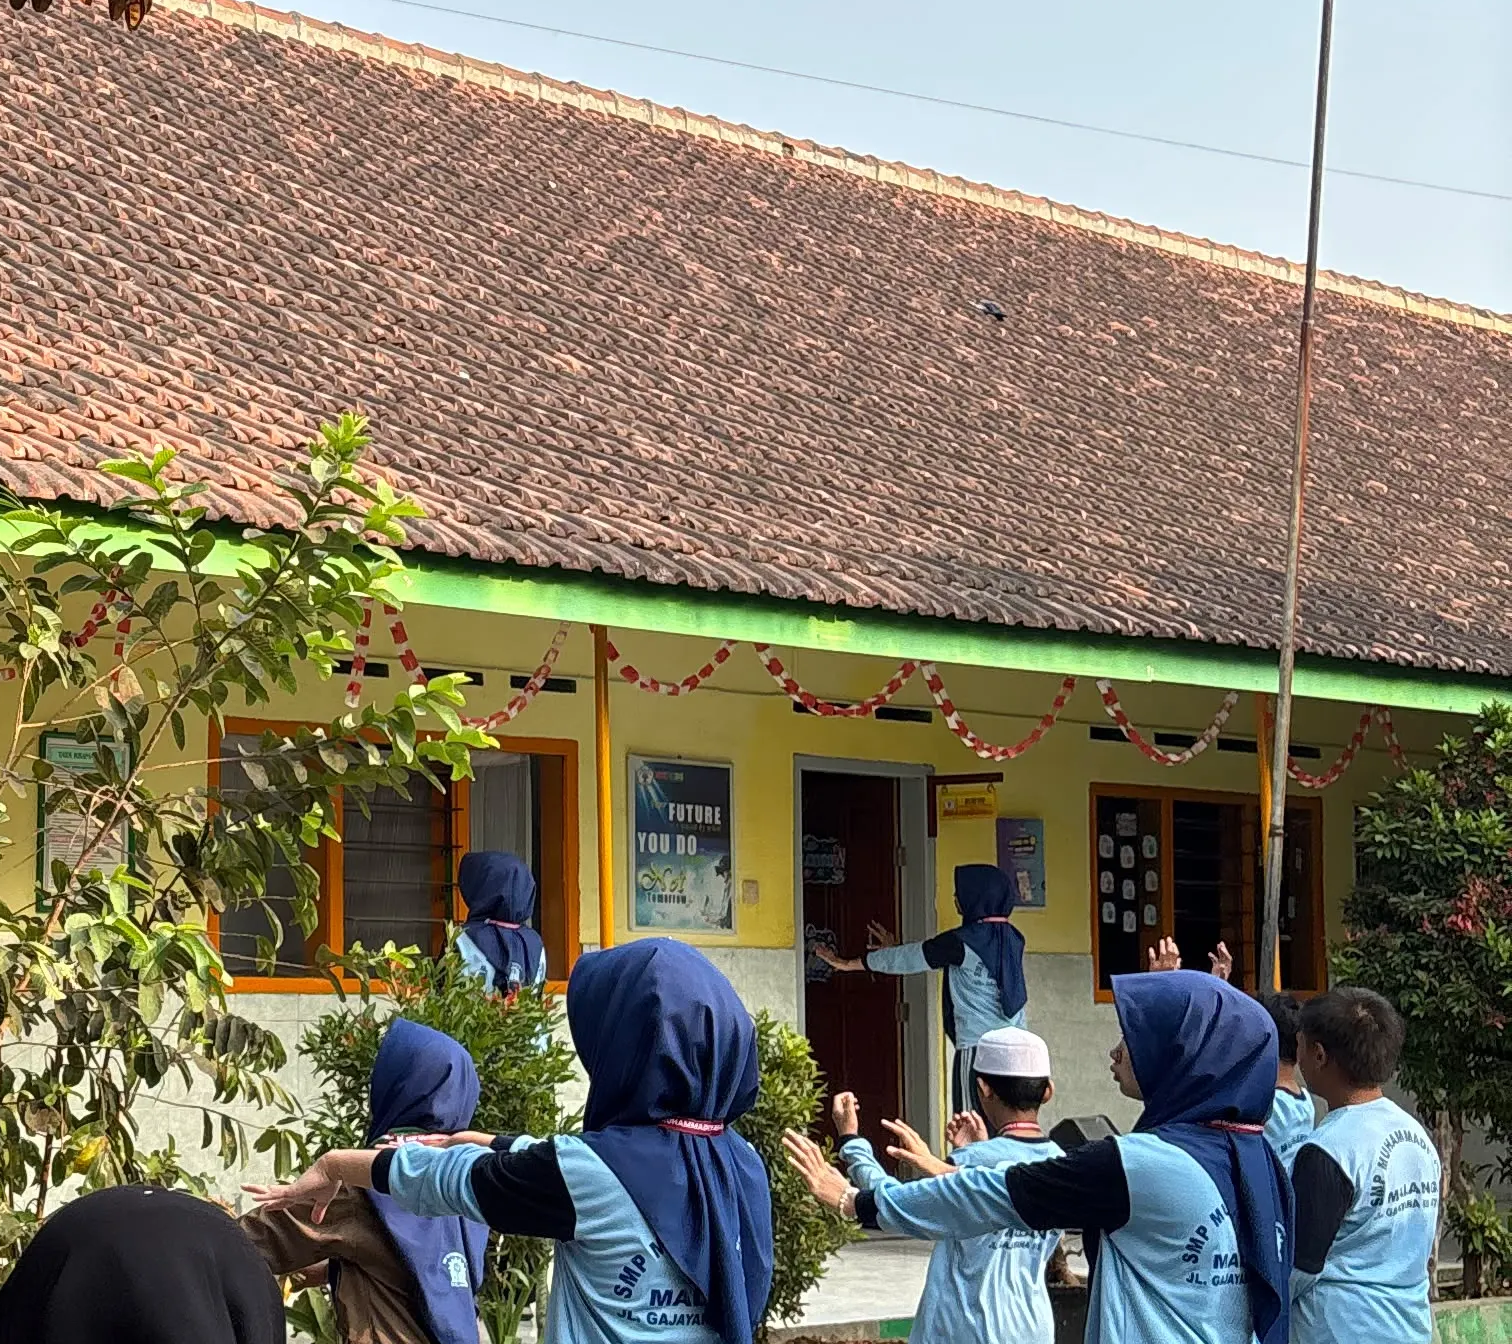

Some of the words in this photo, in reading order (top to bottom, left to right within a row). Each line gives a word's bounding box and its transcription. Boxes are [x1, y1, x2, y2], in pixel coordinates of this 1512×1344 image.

[668, 802, 721, 825] FUTURE
[637, 831, 670, 854] YOU
[676, 834, 697, 855] DO
[1182, 1225, 1209, 1264] SMP
[613, 1254, 647, 1299] SMP
